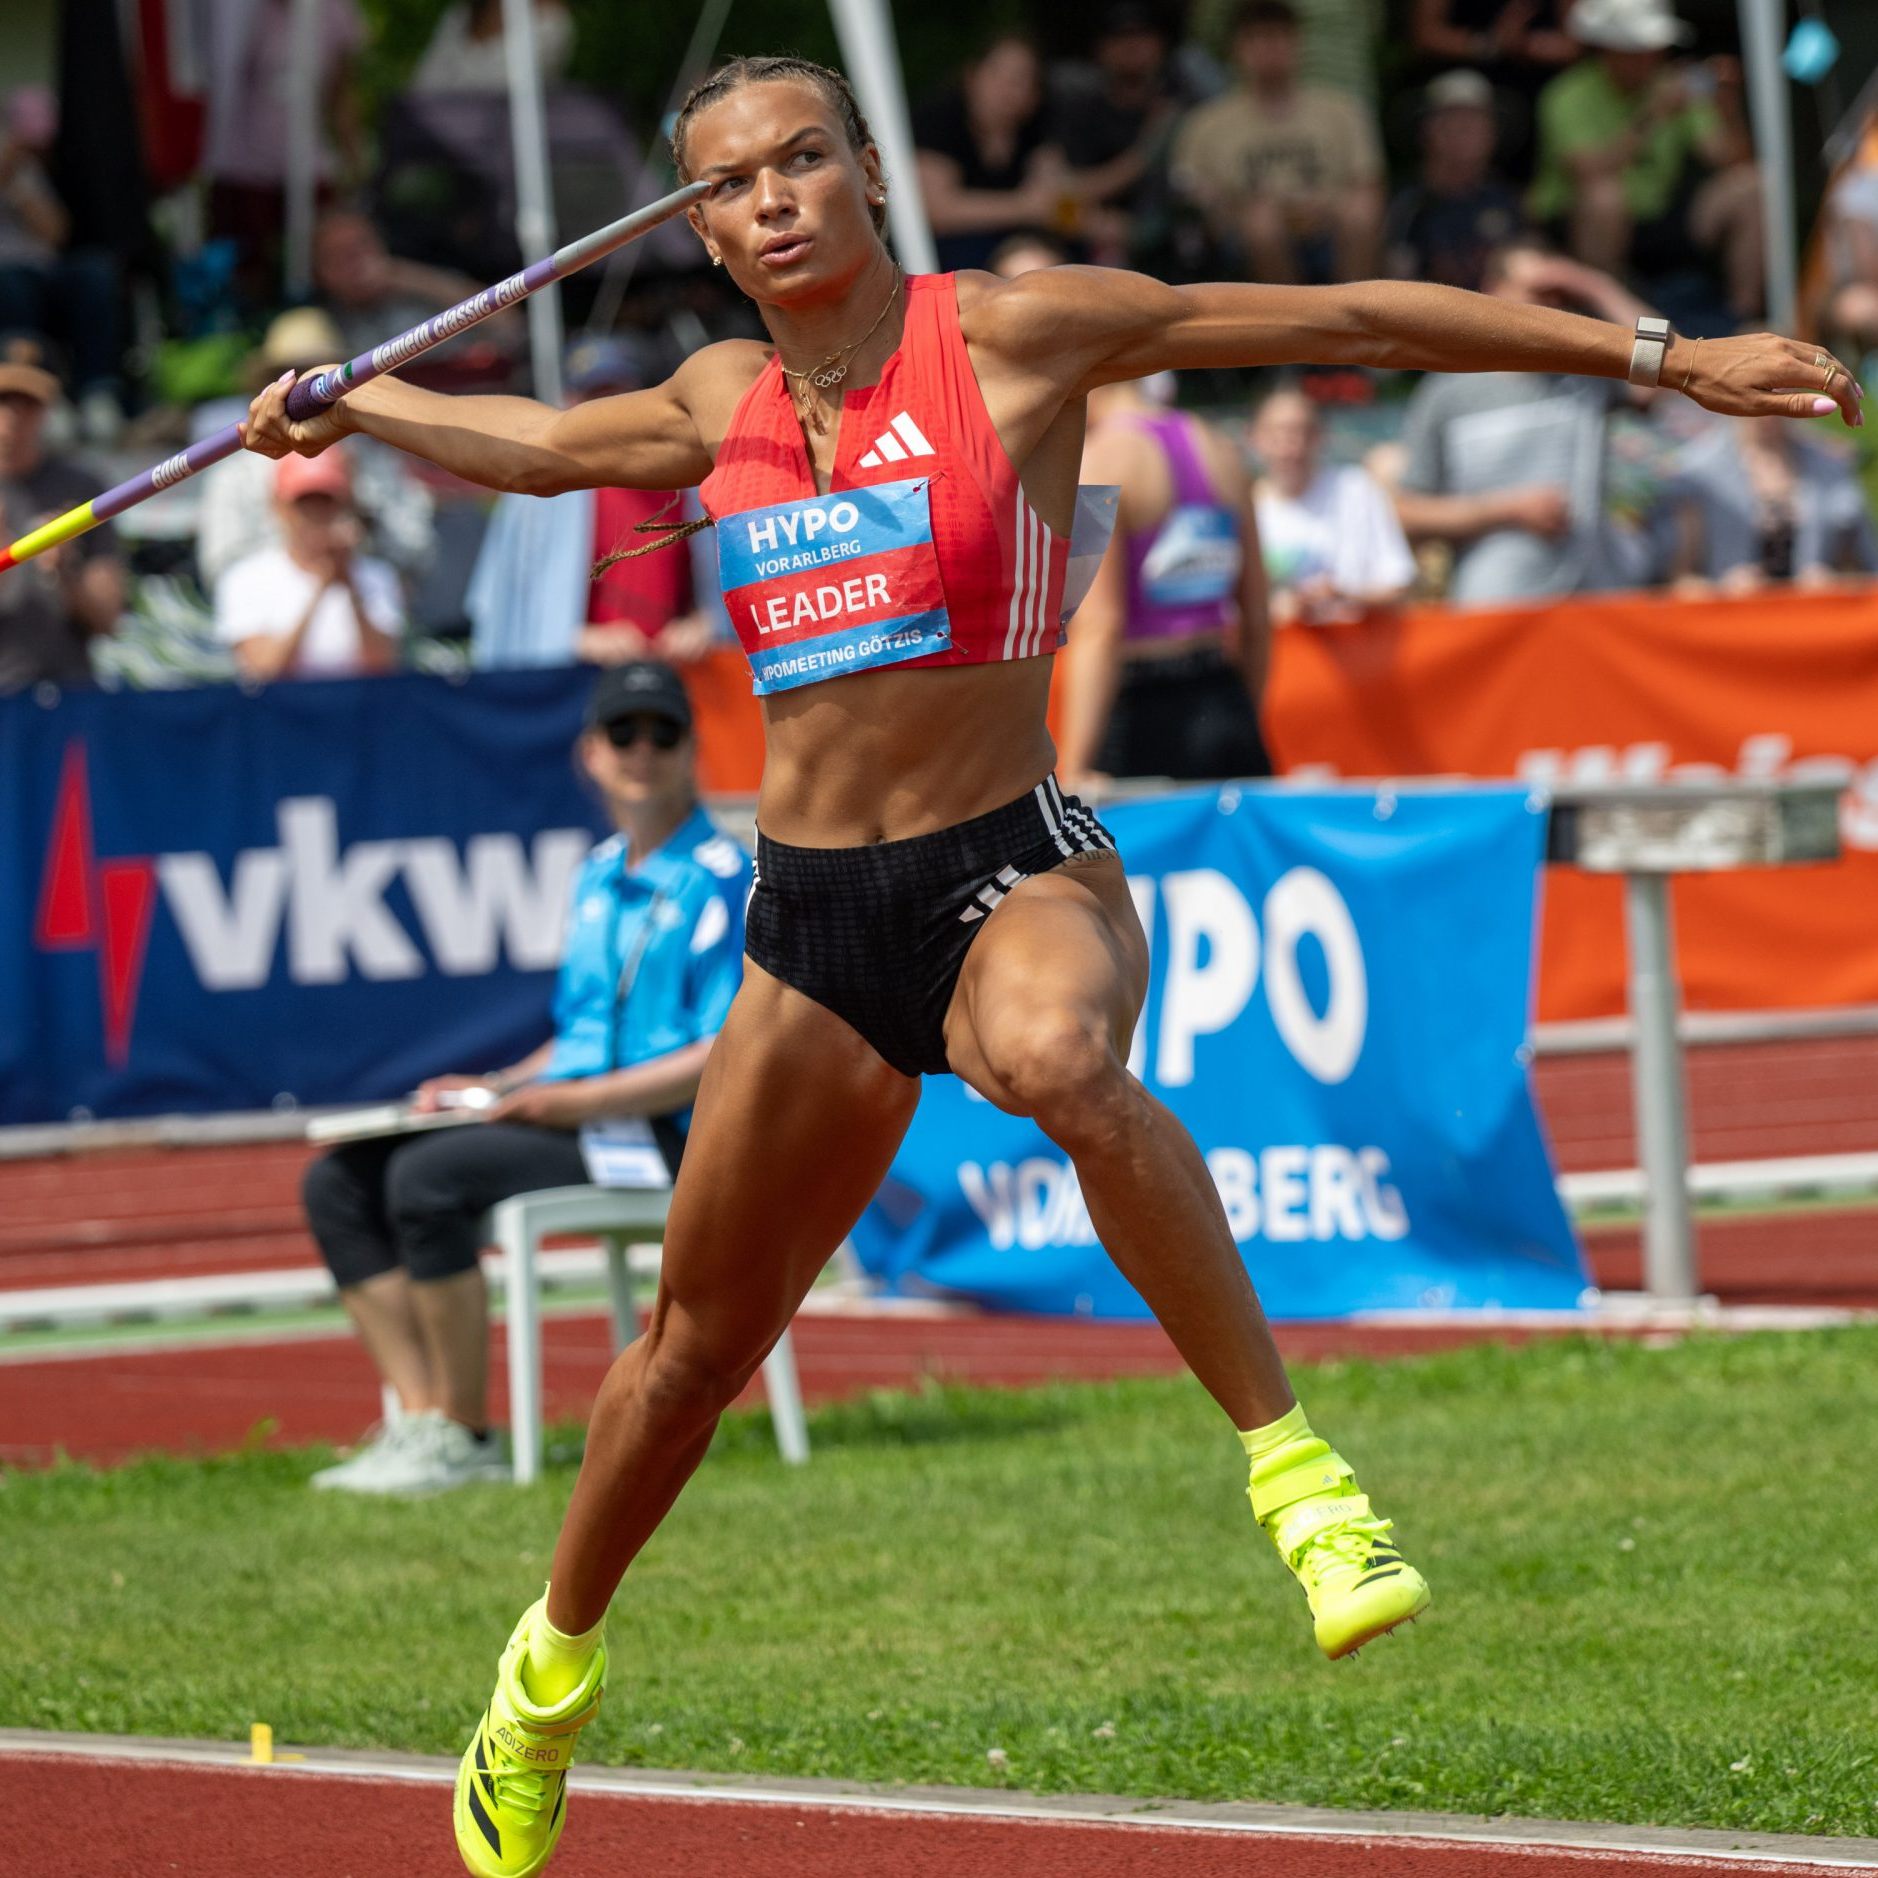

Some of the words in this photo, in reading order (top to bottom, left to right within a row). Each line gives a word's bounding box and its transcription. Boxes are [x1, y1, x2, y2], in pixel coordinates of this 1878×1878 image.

[371, 323, 433, 372] Nemeth
[433, 292, 493, 340] classic
[494, 272, 529, 308] 75m
[748, 502, 859, 553] HYPO
[756, 540, 861, 576] VORARLBERG
[751, 574, 891, 635] LEADER
[858, 629, 923, 658] GÖTZIS
[158, 796, 592, 991] vkw
[496, 1726, 559, 1762] ADIZERO
